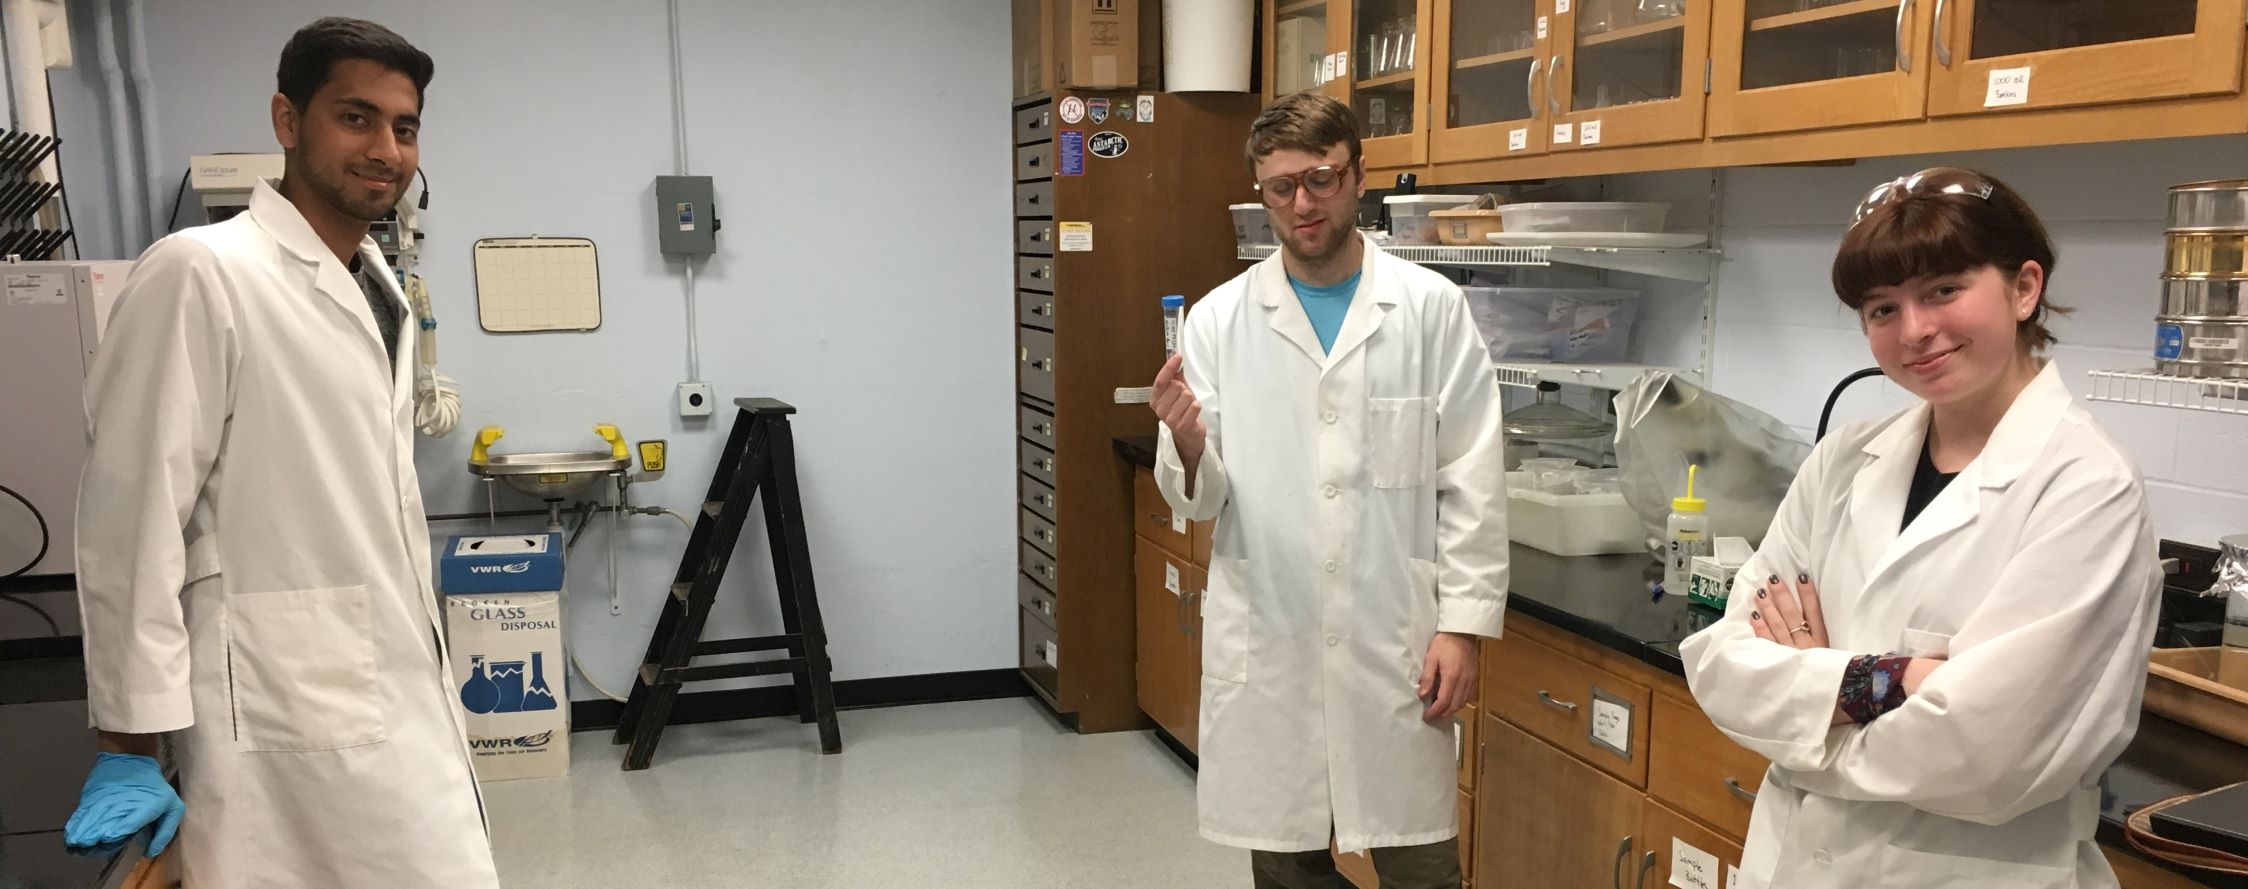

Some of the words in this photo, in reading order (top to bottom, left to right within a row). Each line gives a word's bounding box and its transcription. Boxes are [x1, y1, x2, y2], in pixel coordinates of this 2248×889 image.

[470, 607, 526, 621] GLASS
[501, 620, 557, 631] DISPOSAL
[469, 738, 512, 749] VWR
